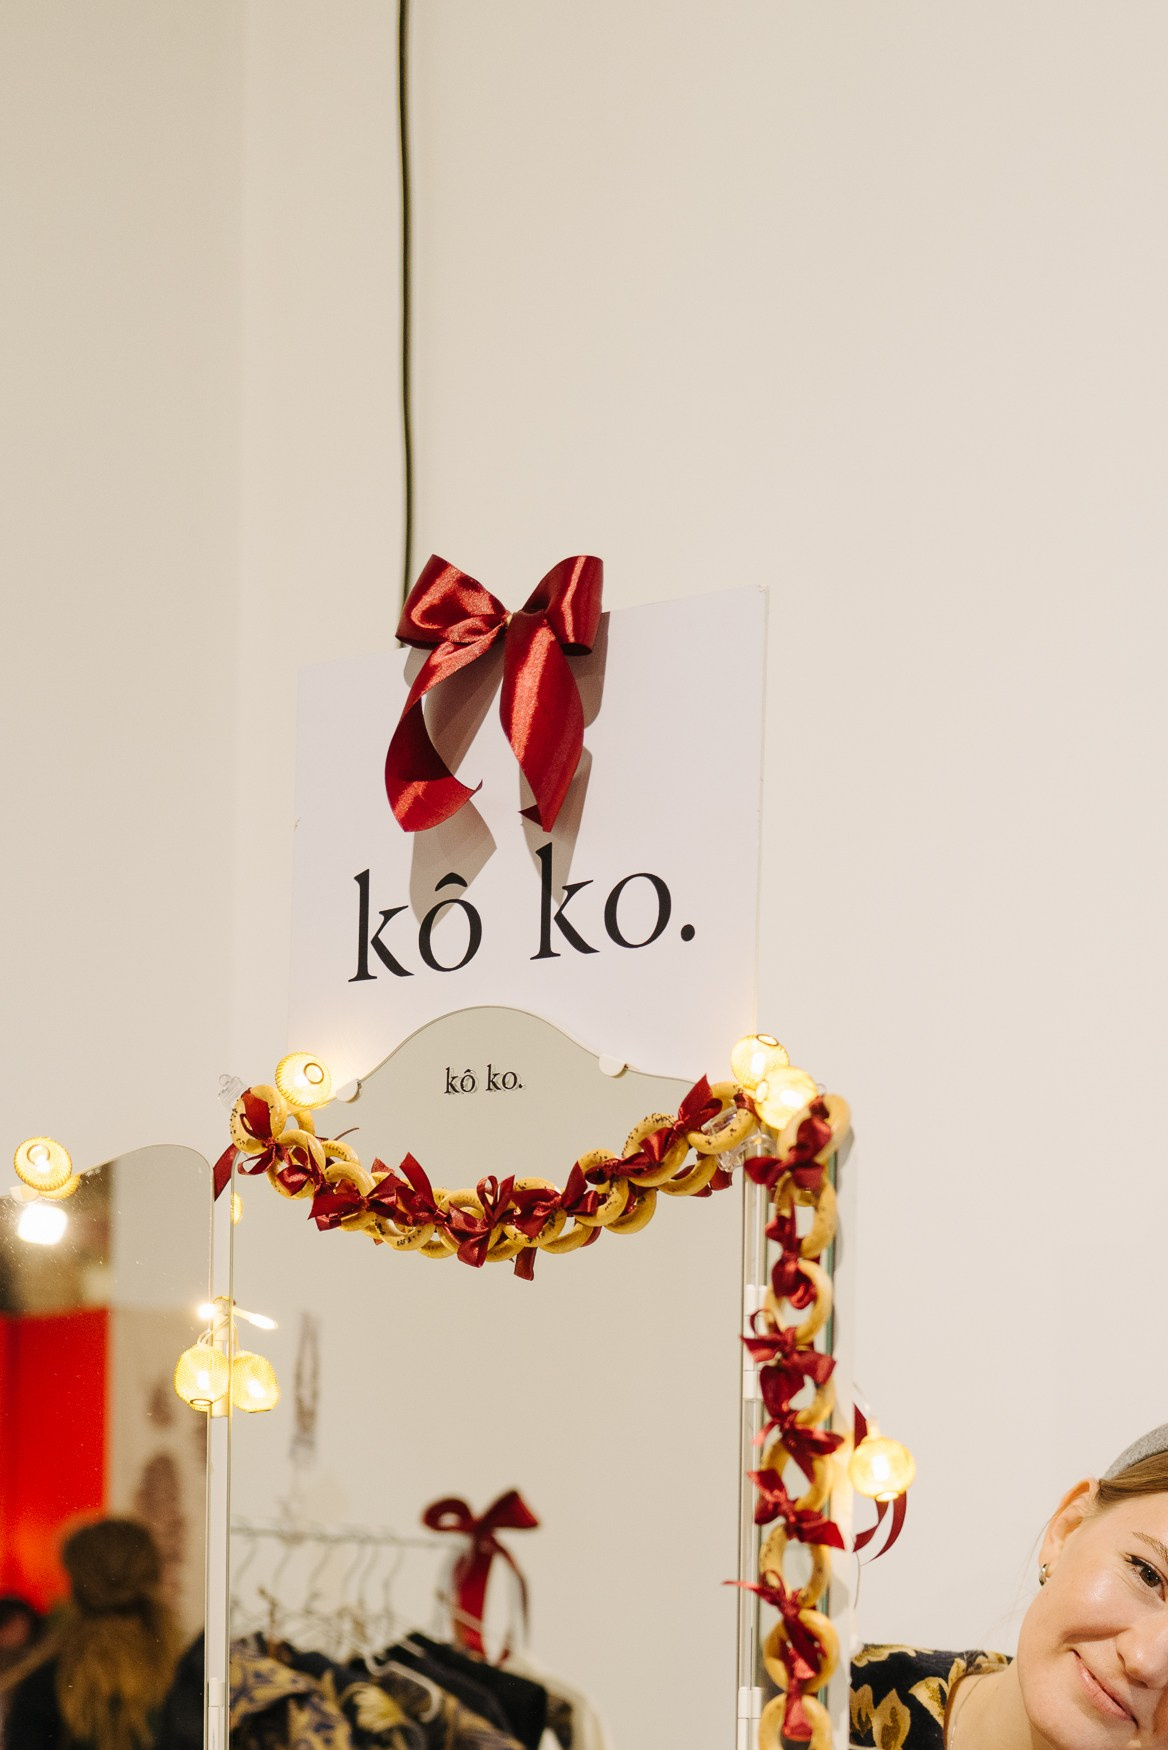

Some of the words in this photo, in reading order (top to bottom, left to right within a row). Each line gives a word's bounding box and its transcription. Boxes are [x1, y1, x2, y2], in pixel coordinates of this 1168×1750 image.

[347, 868, 483, 983] kô
[529, 842, 696, 961] ko.
[444, 1066, 476, 1094] kô
[485, 1063, 523, 1092] ko.
